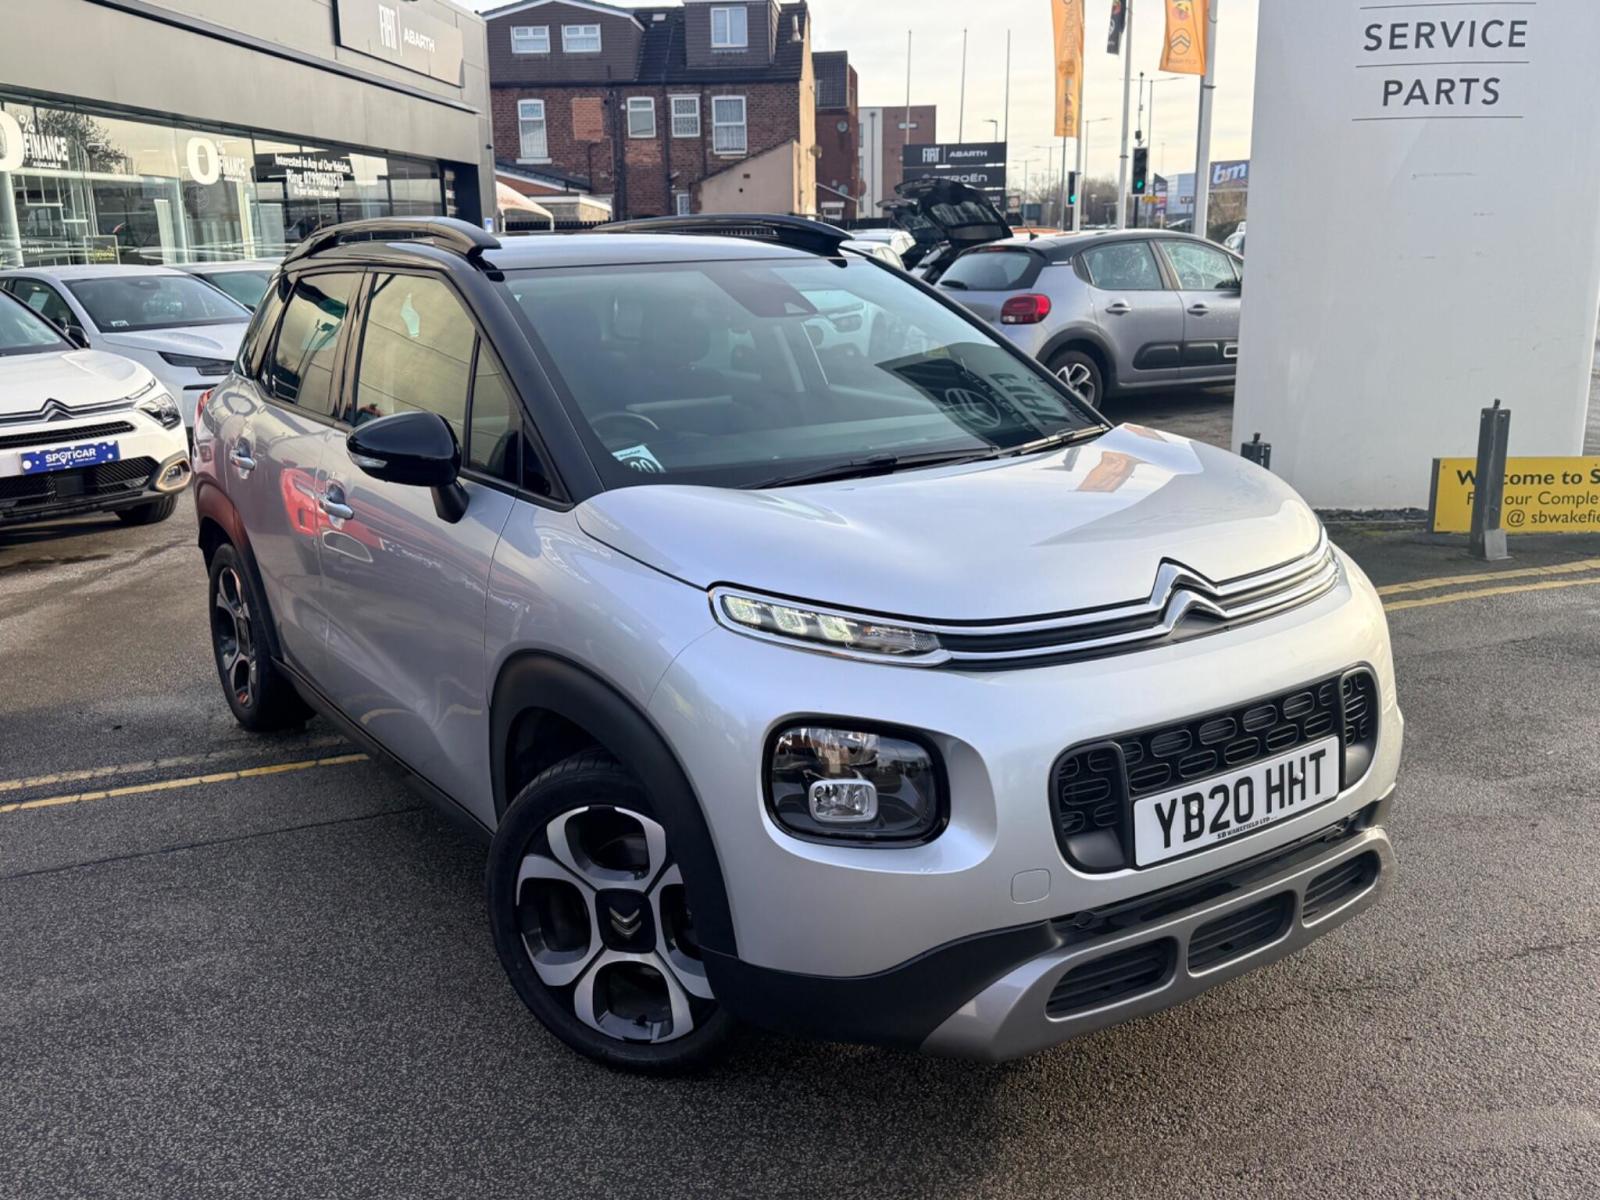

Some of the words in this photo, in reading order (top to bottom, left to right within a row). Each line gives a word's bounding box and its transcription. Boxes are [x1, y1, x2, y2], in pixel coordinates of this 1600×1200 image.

[379, 4, 397, 50] FIAT
[404, 27, 435, 53] ABARTH
[1363, 20, 1528, 51] SERVICE
[1382, 77, 1501, 106] PARTS
[23, 133, 69, 161] FINANCE
[922, 147, 940, 163] FIAT
[949, 150, 988, 158] ABARTH
[1456, 470, 1554, 485] Wome
[1562, 471, 1583, 485] to
[1507, 509, 1525, 527] @
[1154, 776, 1254, 849] YB20
[1265, 748, 1326, 814] HHT
[1227, 821, 1259, 835] WAKEFIELD
